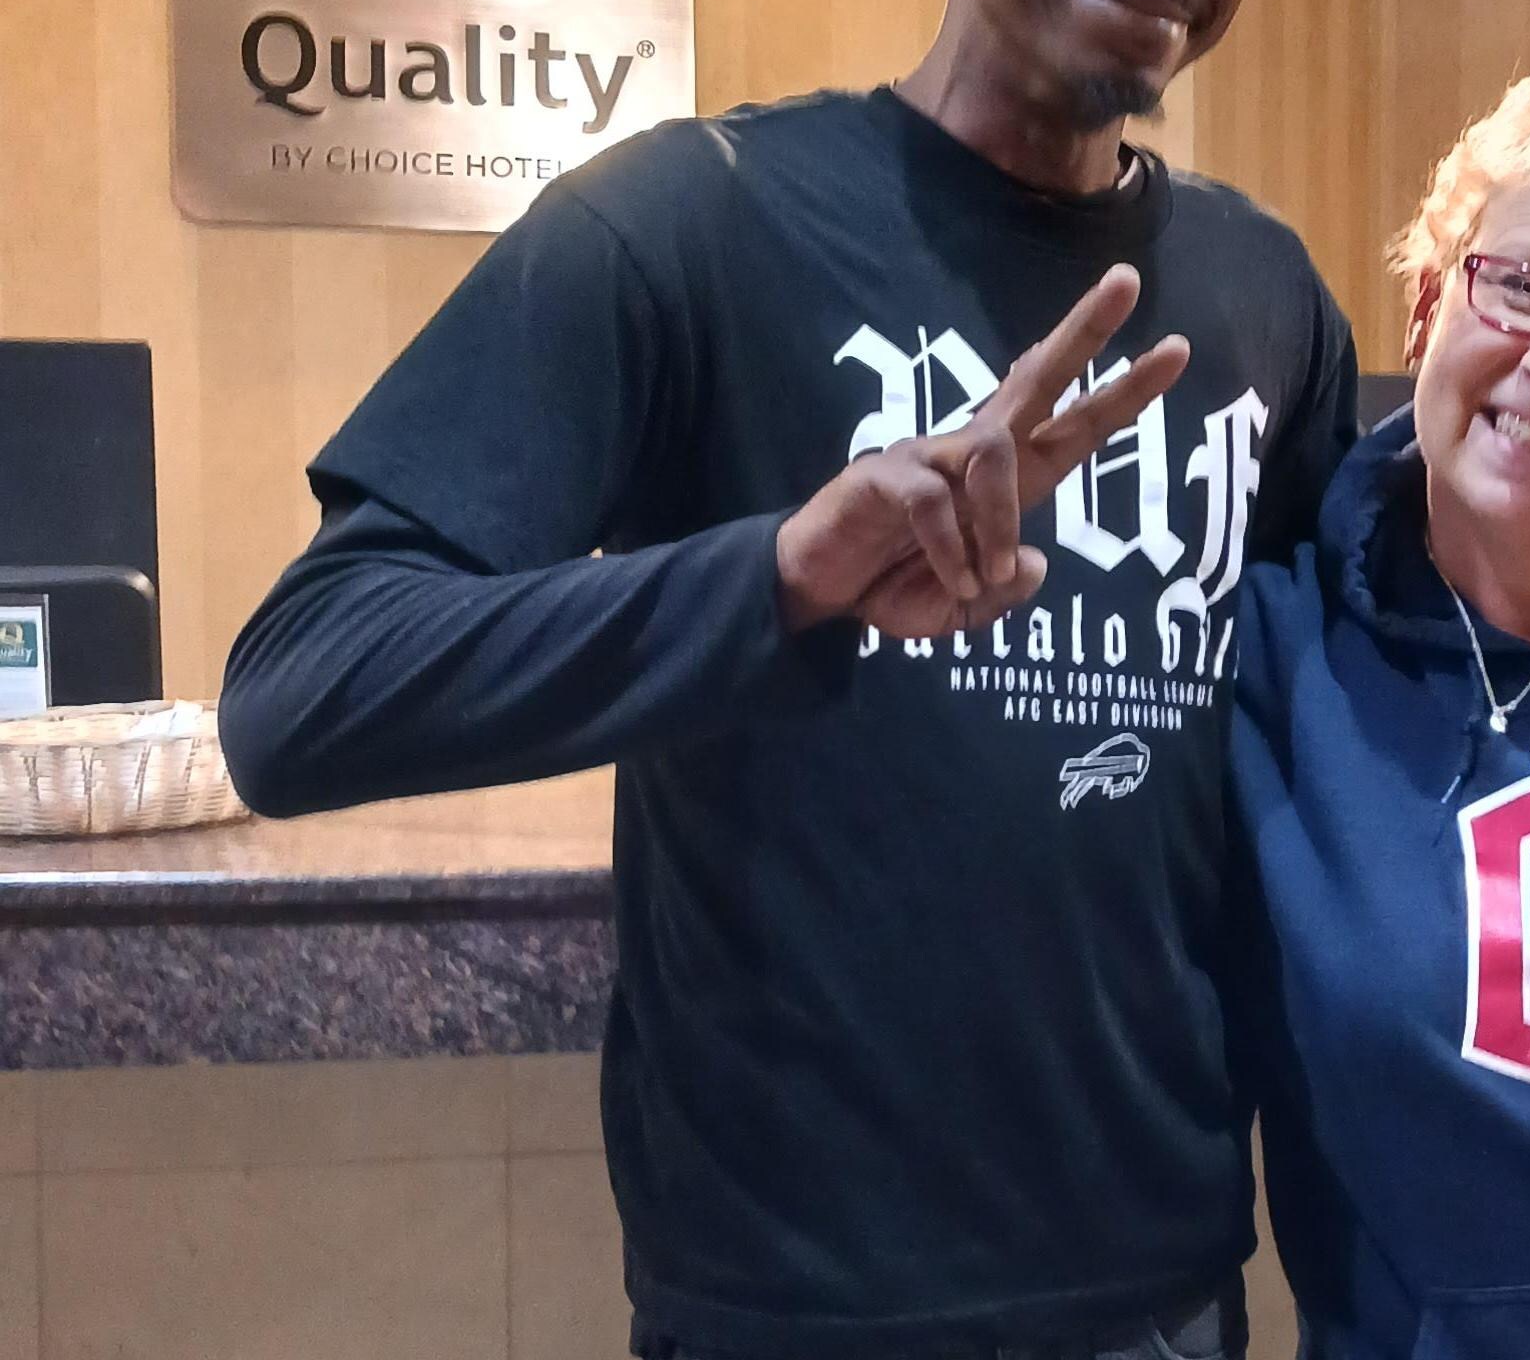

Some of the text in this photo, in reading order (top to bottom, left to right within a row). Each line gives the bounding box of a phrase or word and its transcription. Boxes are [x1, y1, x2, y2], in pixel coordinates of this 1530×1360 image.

[271, 143, 313, 170] BY
[326, 145, 455, 176] CHOICE
[950, 666, 1055, 694] NATIONAL
[1067, 671, 1157, 701] FOOTBALL
[1004, 696, 1182, 730] AFC EAST DIVISION
